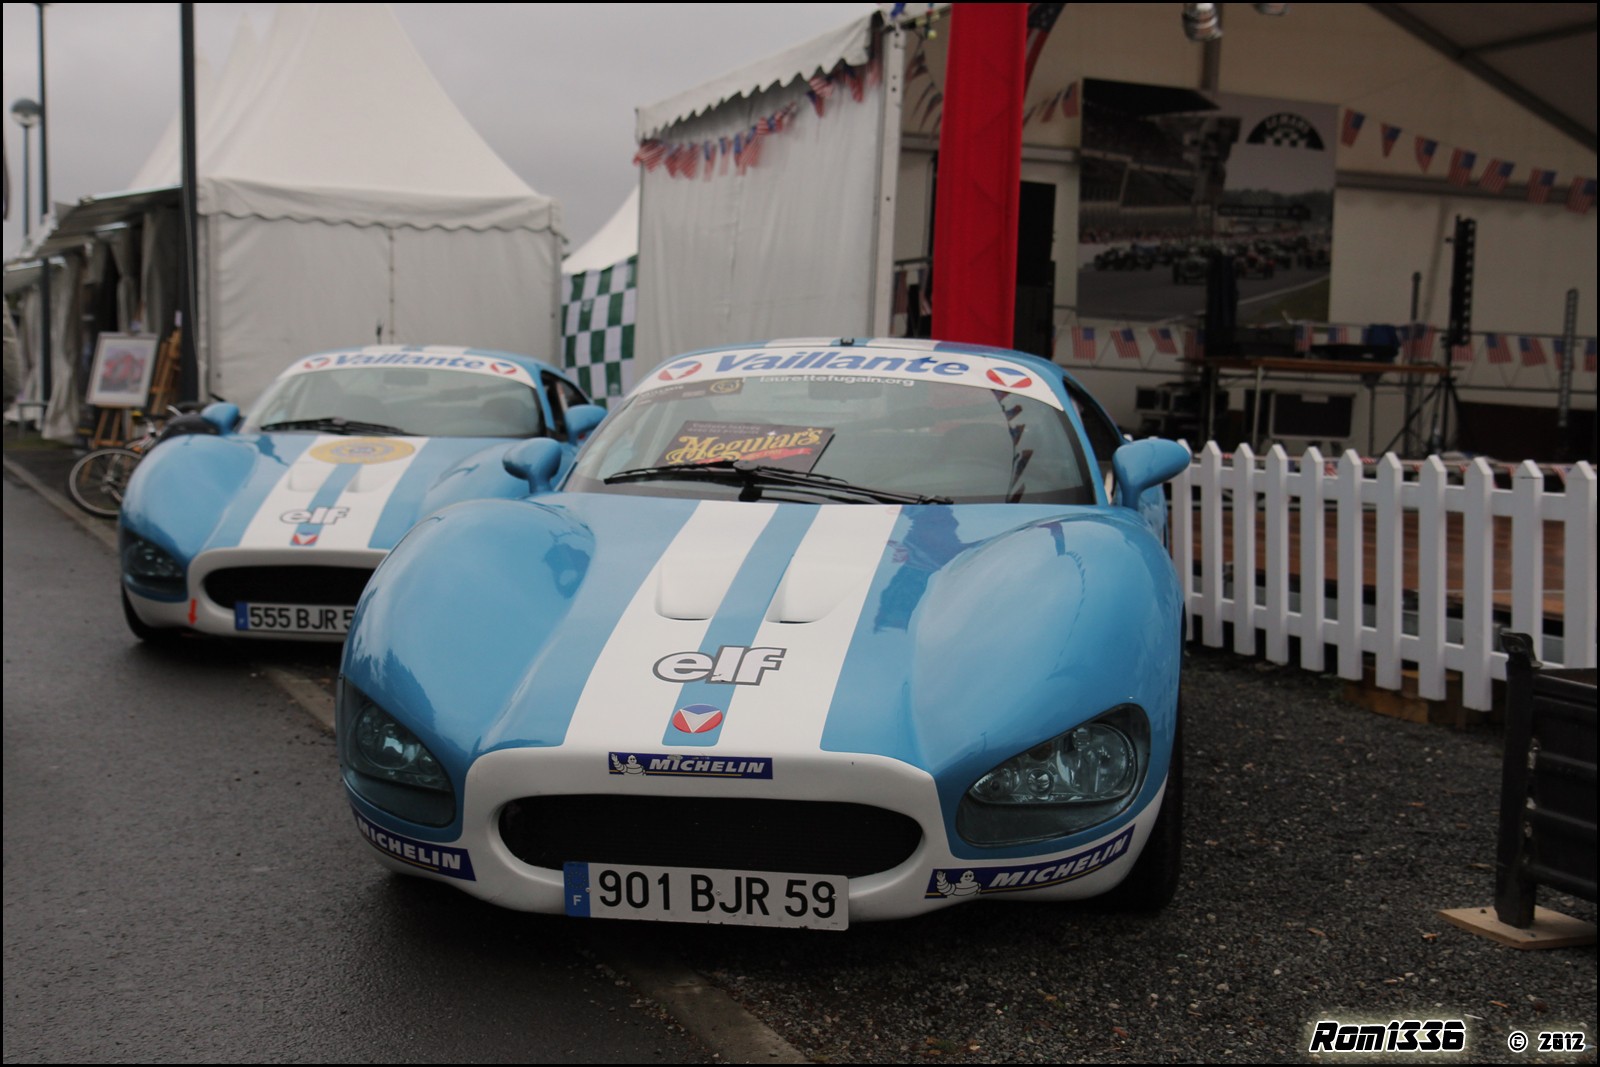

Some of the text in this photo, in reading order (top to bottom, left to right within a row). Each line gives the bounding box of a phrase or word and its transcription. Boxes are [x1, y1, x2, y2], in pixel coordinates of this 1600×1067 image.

[335, 353, 485, 369] Vaillante
[715, 351, 970, 376] Vaillante
[665, 427, 823, 465] Meguiar's
[279, 506, 351, 525] elf
[250, 606, 291, 629] 555
[296, 608, 338, 631] BJR
[652, 645, 787, 686] elf
[649, 758, 766, 774] MICHELIN
[356, 815, 461, 871] MICHELIN
[988, 834, 1129, 888] MICHELIN
[572, 894, 583, 906] F
[598, 869, 837, 919] 901 BJR 59
